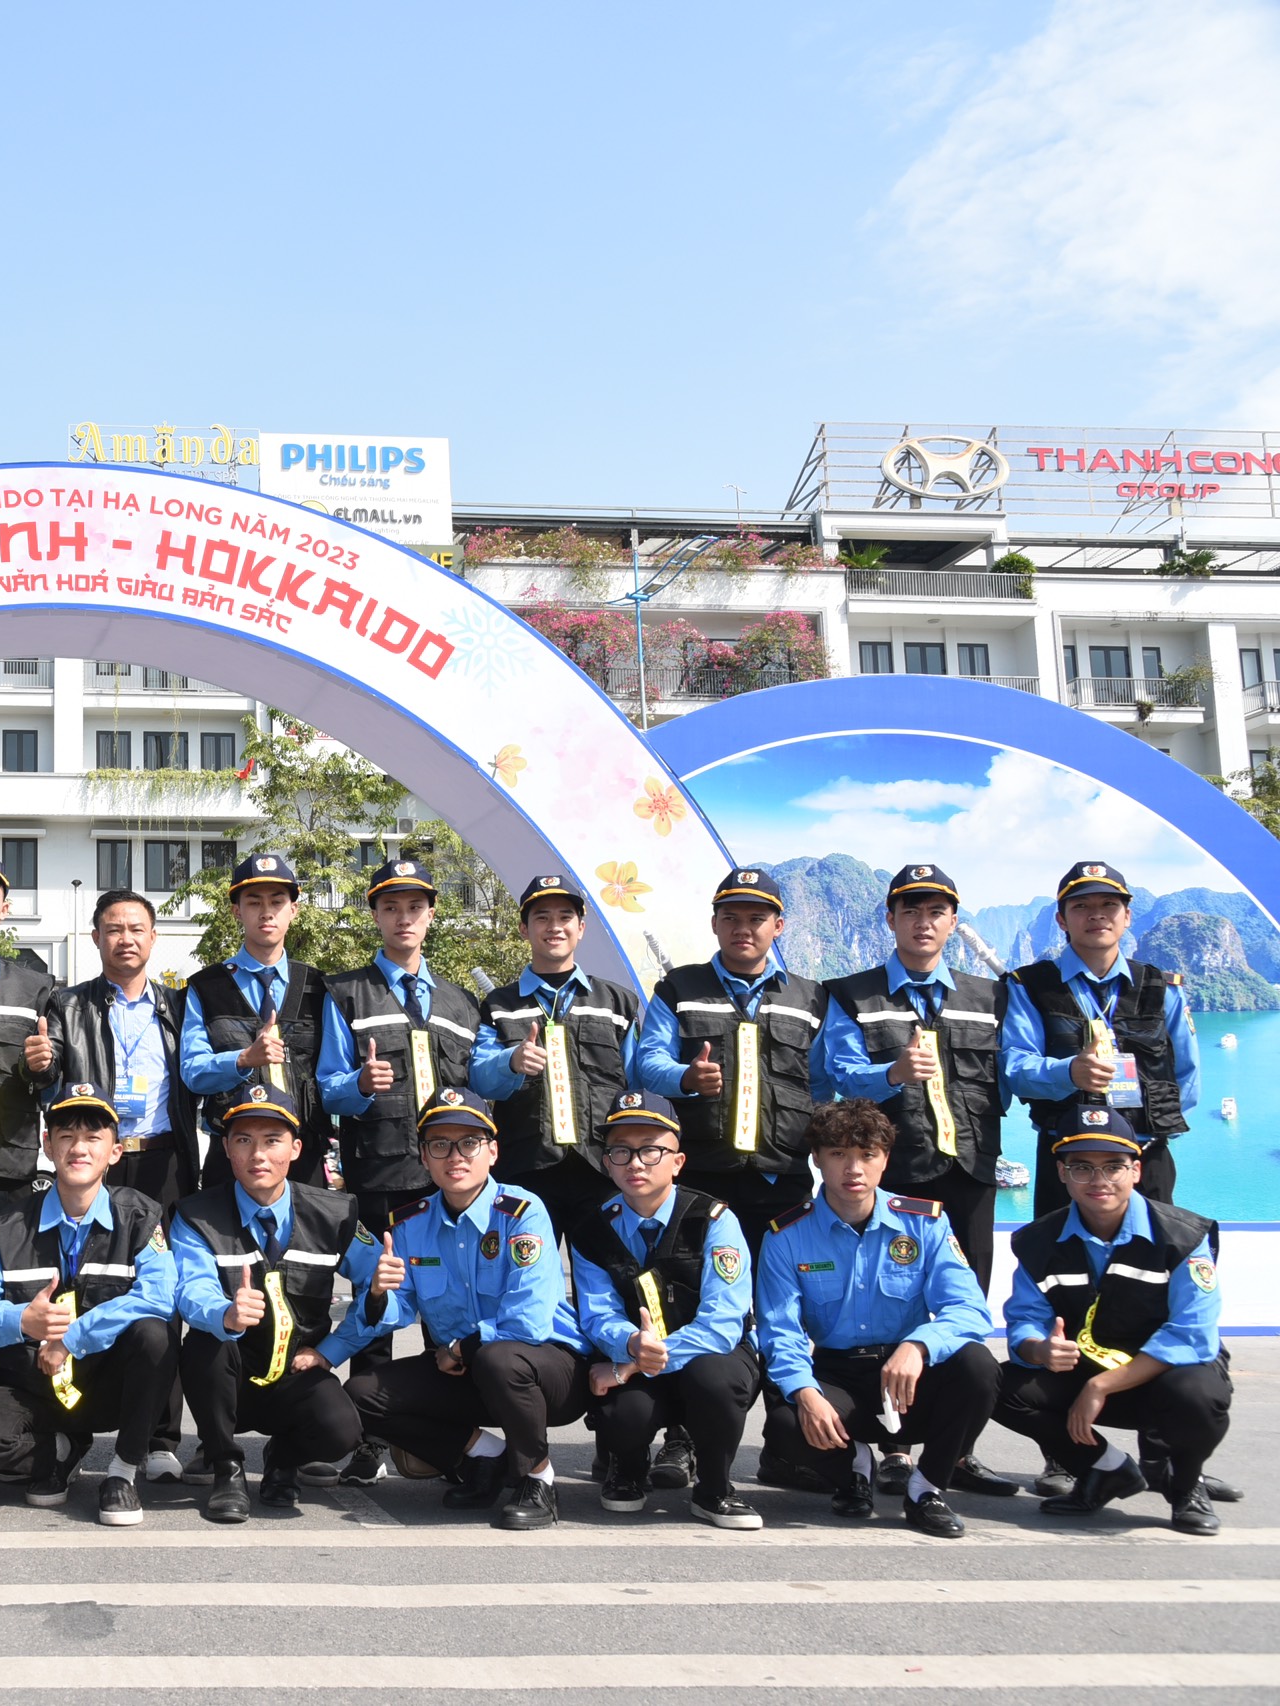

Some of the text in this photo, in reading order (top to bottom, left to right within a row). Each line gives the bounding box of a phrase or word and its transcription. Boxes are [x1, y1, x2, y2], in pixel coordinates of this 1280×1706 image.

[68, 421, 260, 468] Amanda
[280, 443, 425, 475] PHILIPS
[1027, 447, 1183, 474] THANH
[360, 475, 391, 490] sáng
[1117, 482, 1221, 499] GROUP
[50, 488, 94, 513] TẠI
[103, 490, 146, 517] HẠ
[150, 490, 223, 526] LONG
[231, 513, 291, 545] NĂM
[295, 533, 361, 570] 2023
[56, 569, 109, 593] HOÁ
[116, 573, 174, 601] GIÀU
[182, 584, 234, 616] BẢN
[240, 597, 293, 634] SẮC
[155, 529, 456, 680] HOKKAIDO
[551, 1037, 567, 1130] SECURITY
[742, 1035, 753, 1135] SECURITY
[273, 1286, 289, 1379] SECURIT
